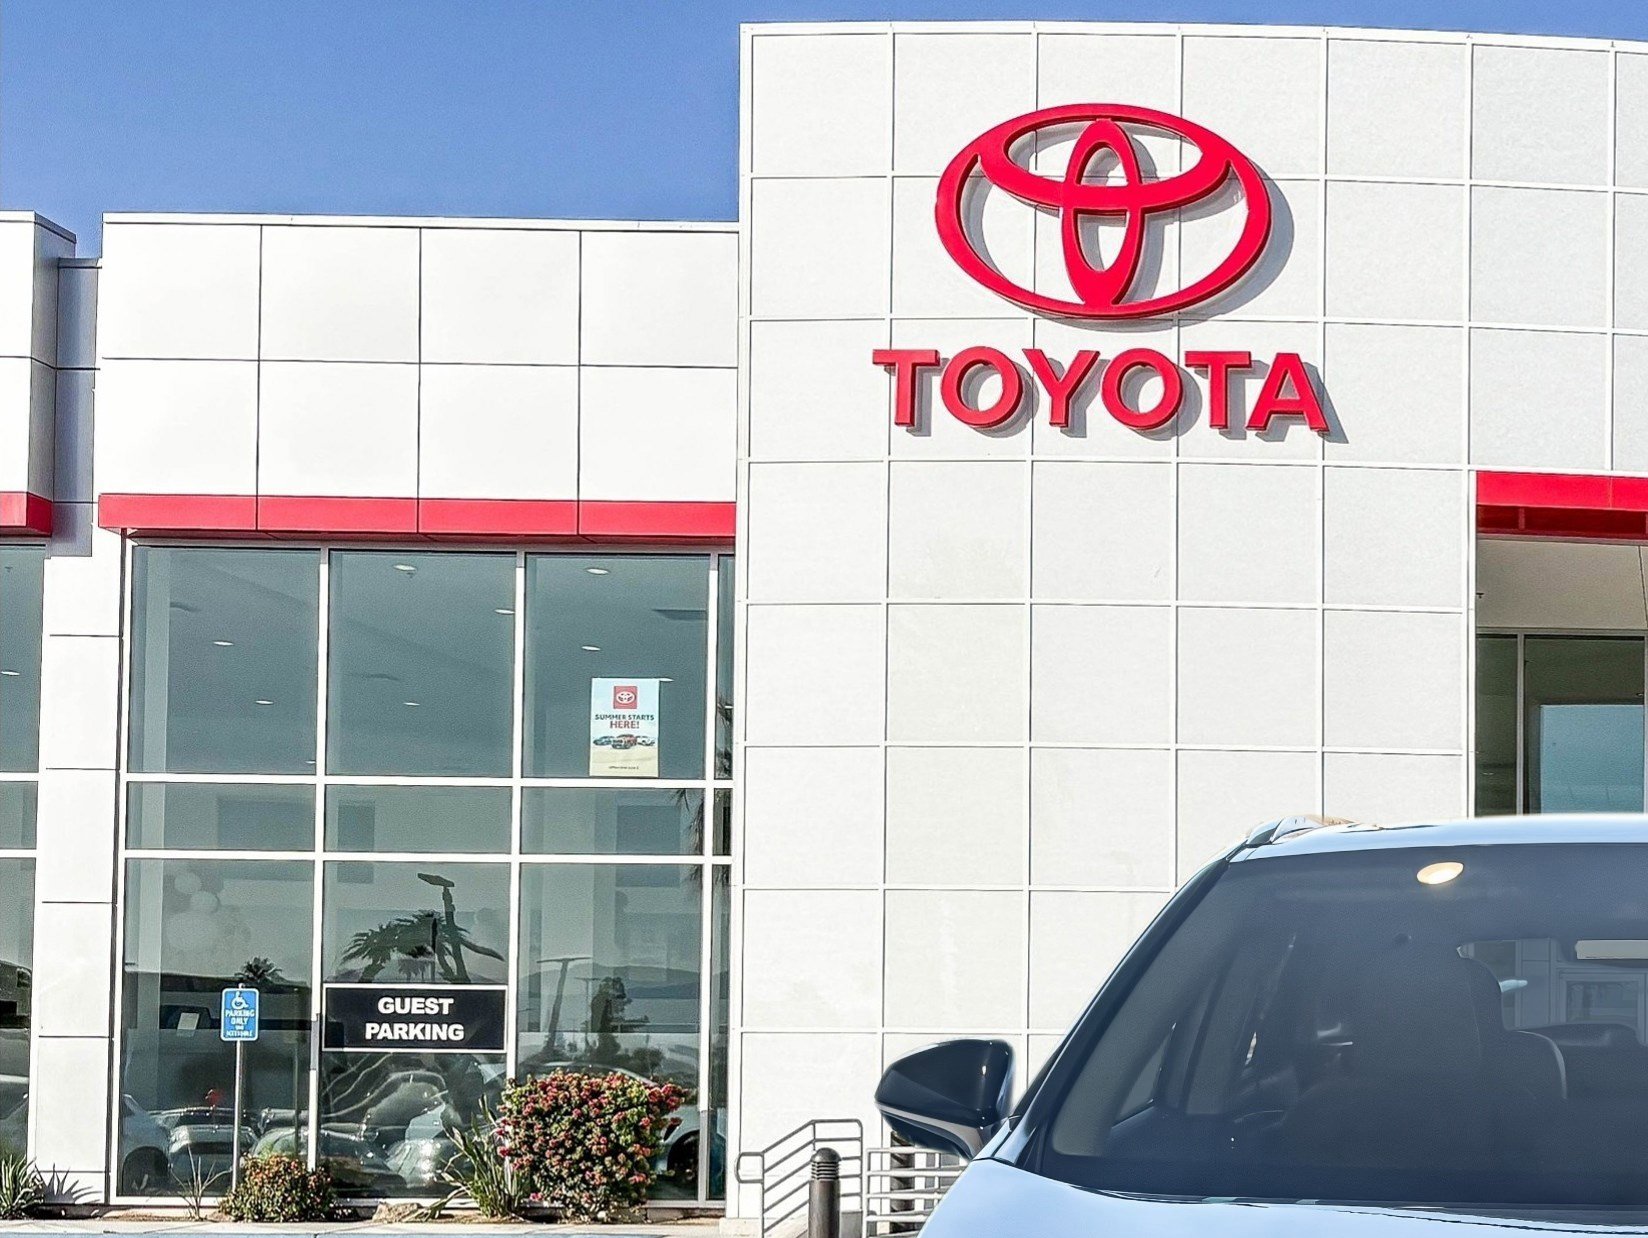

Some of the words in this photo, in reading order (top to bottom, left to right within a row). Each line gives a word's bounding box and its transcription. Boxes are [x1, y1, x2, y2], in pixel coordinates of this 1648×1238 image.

[872, 346, 1330, 432] TOYOTA
[609, 720, 640, 729] HERE!
[377, 997, 454, 1015] GUEST
[364, 1022, 465, 1041] PARKING
